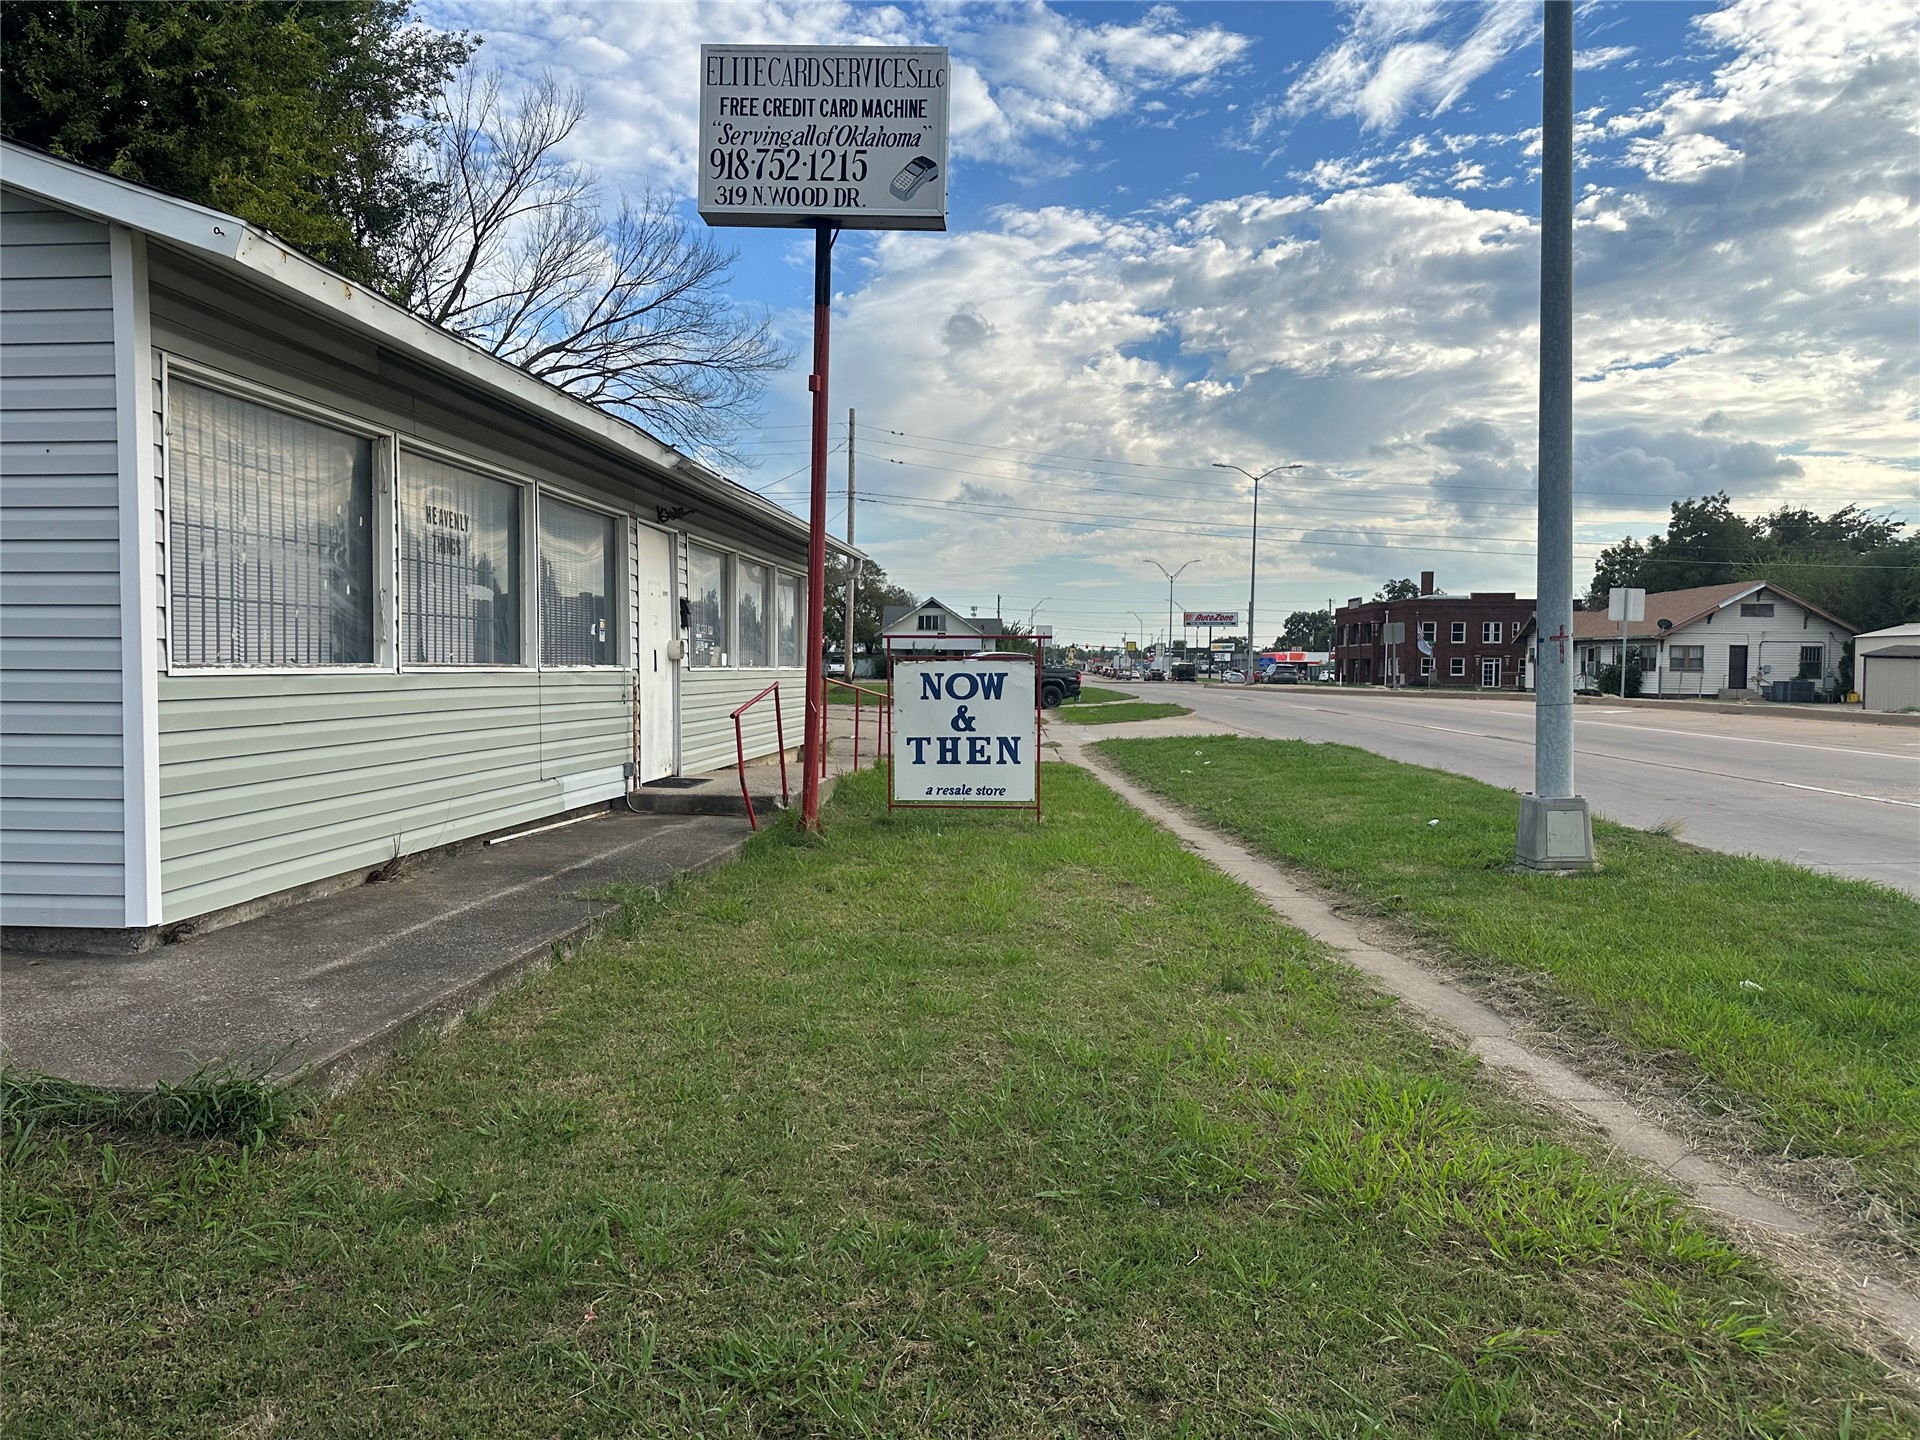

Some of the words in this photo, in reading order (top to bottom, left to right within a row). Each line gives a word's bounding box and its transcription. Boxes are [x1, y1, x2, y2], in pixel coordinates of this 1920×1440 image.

[707, 56, 766, 87] ELITE
[767, 57, 820, 88] CARD
[822, 58, 919, 88] SERVICES
[917, 69, 945, 88] LLC
[720, 96, 759, 117] FREE
[762, 97, 816, 118] CREDIT
[819, 98, 858, 119] CARD
[861, 98, 928, 119] MACHINE
[791, 123, 817, 147] all
[815, 125, 838, 147] of
[714, 185, 748, 206] 319
[767, 186, 828, 207] WOOD
[833, 187, 867, 207] DR.
[425, 505, 469, 533] HEAVENLY
[431, 534, 461, 556] THINGS
[1195, 613, 1234, 621] AutoZone
[919, 672, 1009, 701] NOW
[950, 704, 977, 732] &
[906, 736, 1022, 765] THEN
[925, 786, 934, 796] a
[936, 784, 972, 796] resale
[975, 786, 1007, 797] store
